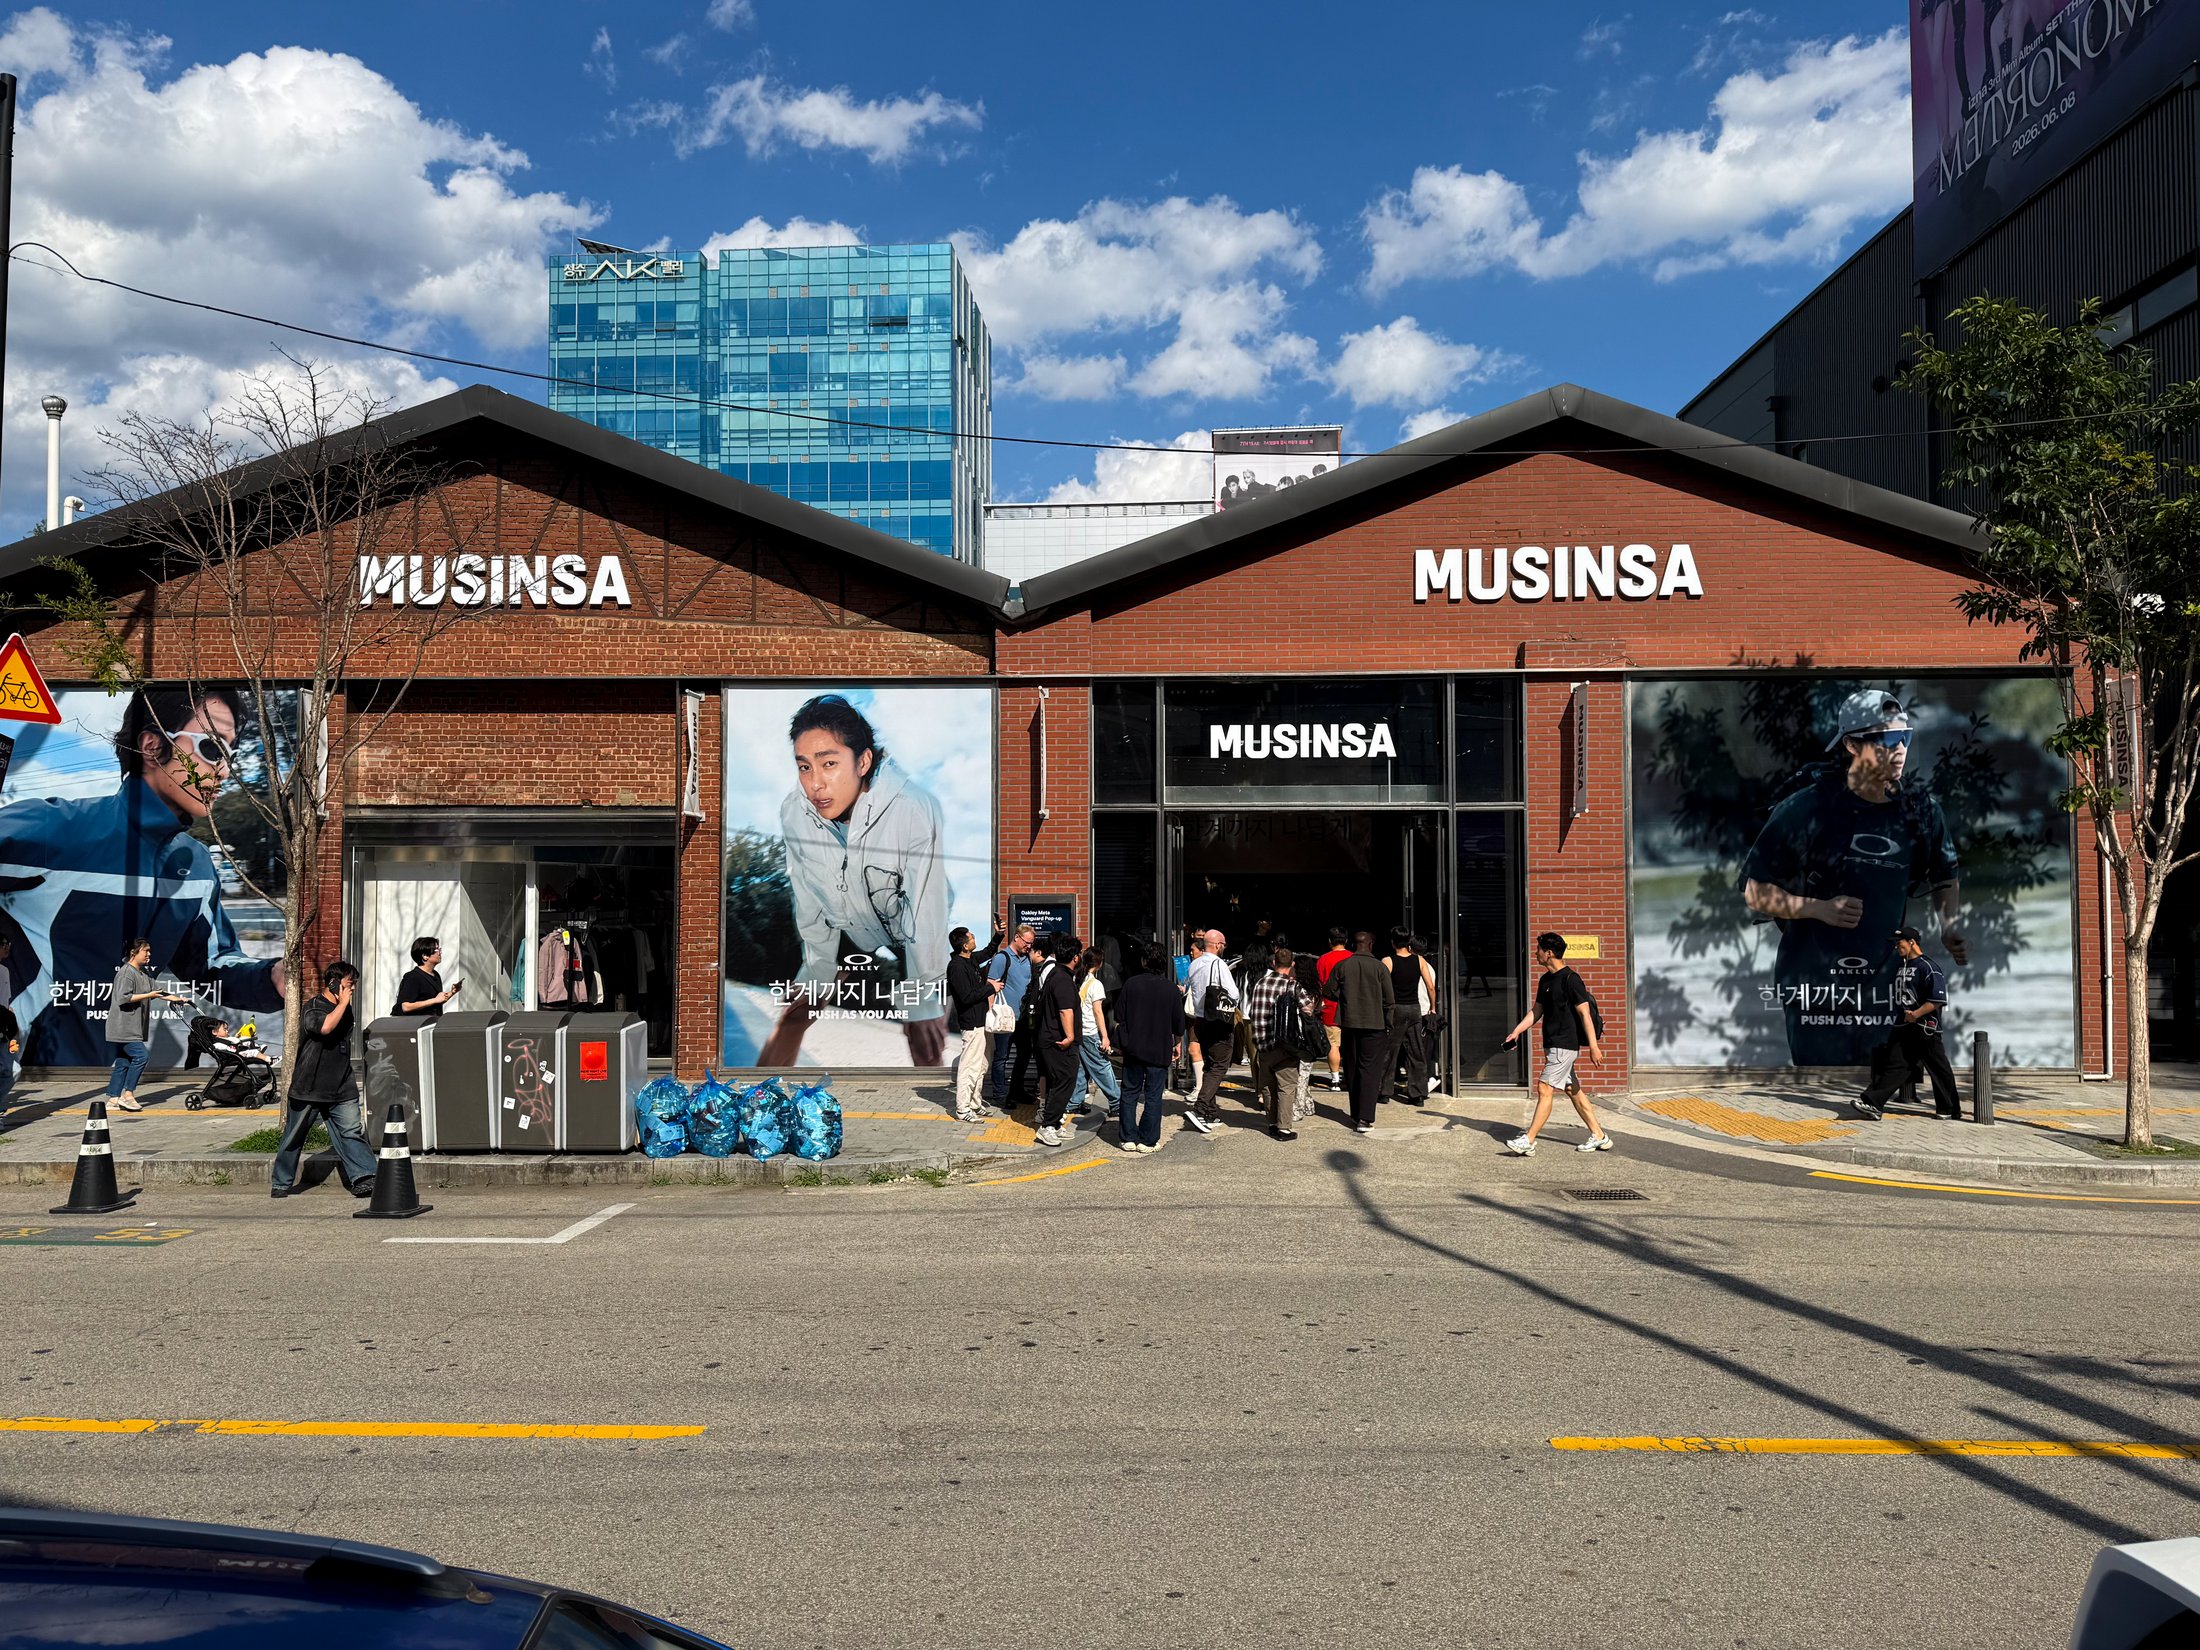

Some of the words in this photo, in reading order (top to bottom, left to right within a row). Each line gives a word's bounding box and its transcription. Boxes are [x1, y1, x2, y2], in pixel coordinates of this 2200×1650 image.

[1968, 84, 1988, 111] izna
[1988, 72, 2001, 91] 3rd
[2001, 57, 2018, 78] Mini
[2018, 32, 2043, 63] Album
[2045, 14, 2064, 36] SET
[359, 553, 632, 608] MUSINSA
[1414, 543, 1704, 603] MUSINSA
[1210, 722, 1397, 759] MUSINSA
[1566, 943, 1596, 951] USINSA
[768, 978, 866, 1007] 한계까지
[875, 978, 948, 1007] 나답게
[1758, 983, 1862, 1012] 한계까지
[86, 1010, 109, 1020] PUS
[808, 1009, 839, 1020] PUSH
[841, 1009, 857, 1020] AS
[859, 1009, 884, 1020] YOU
[885, 1009, 909, 1020] ARE
[1801, 1015, 1835, 1026] PUSH
[1836, 1015, 1853, 1026] AS
[1854, 1015, 1882, 1026] YOU
